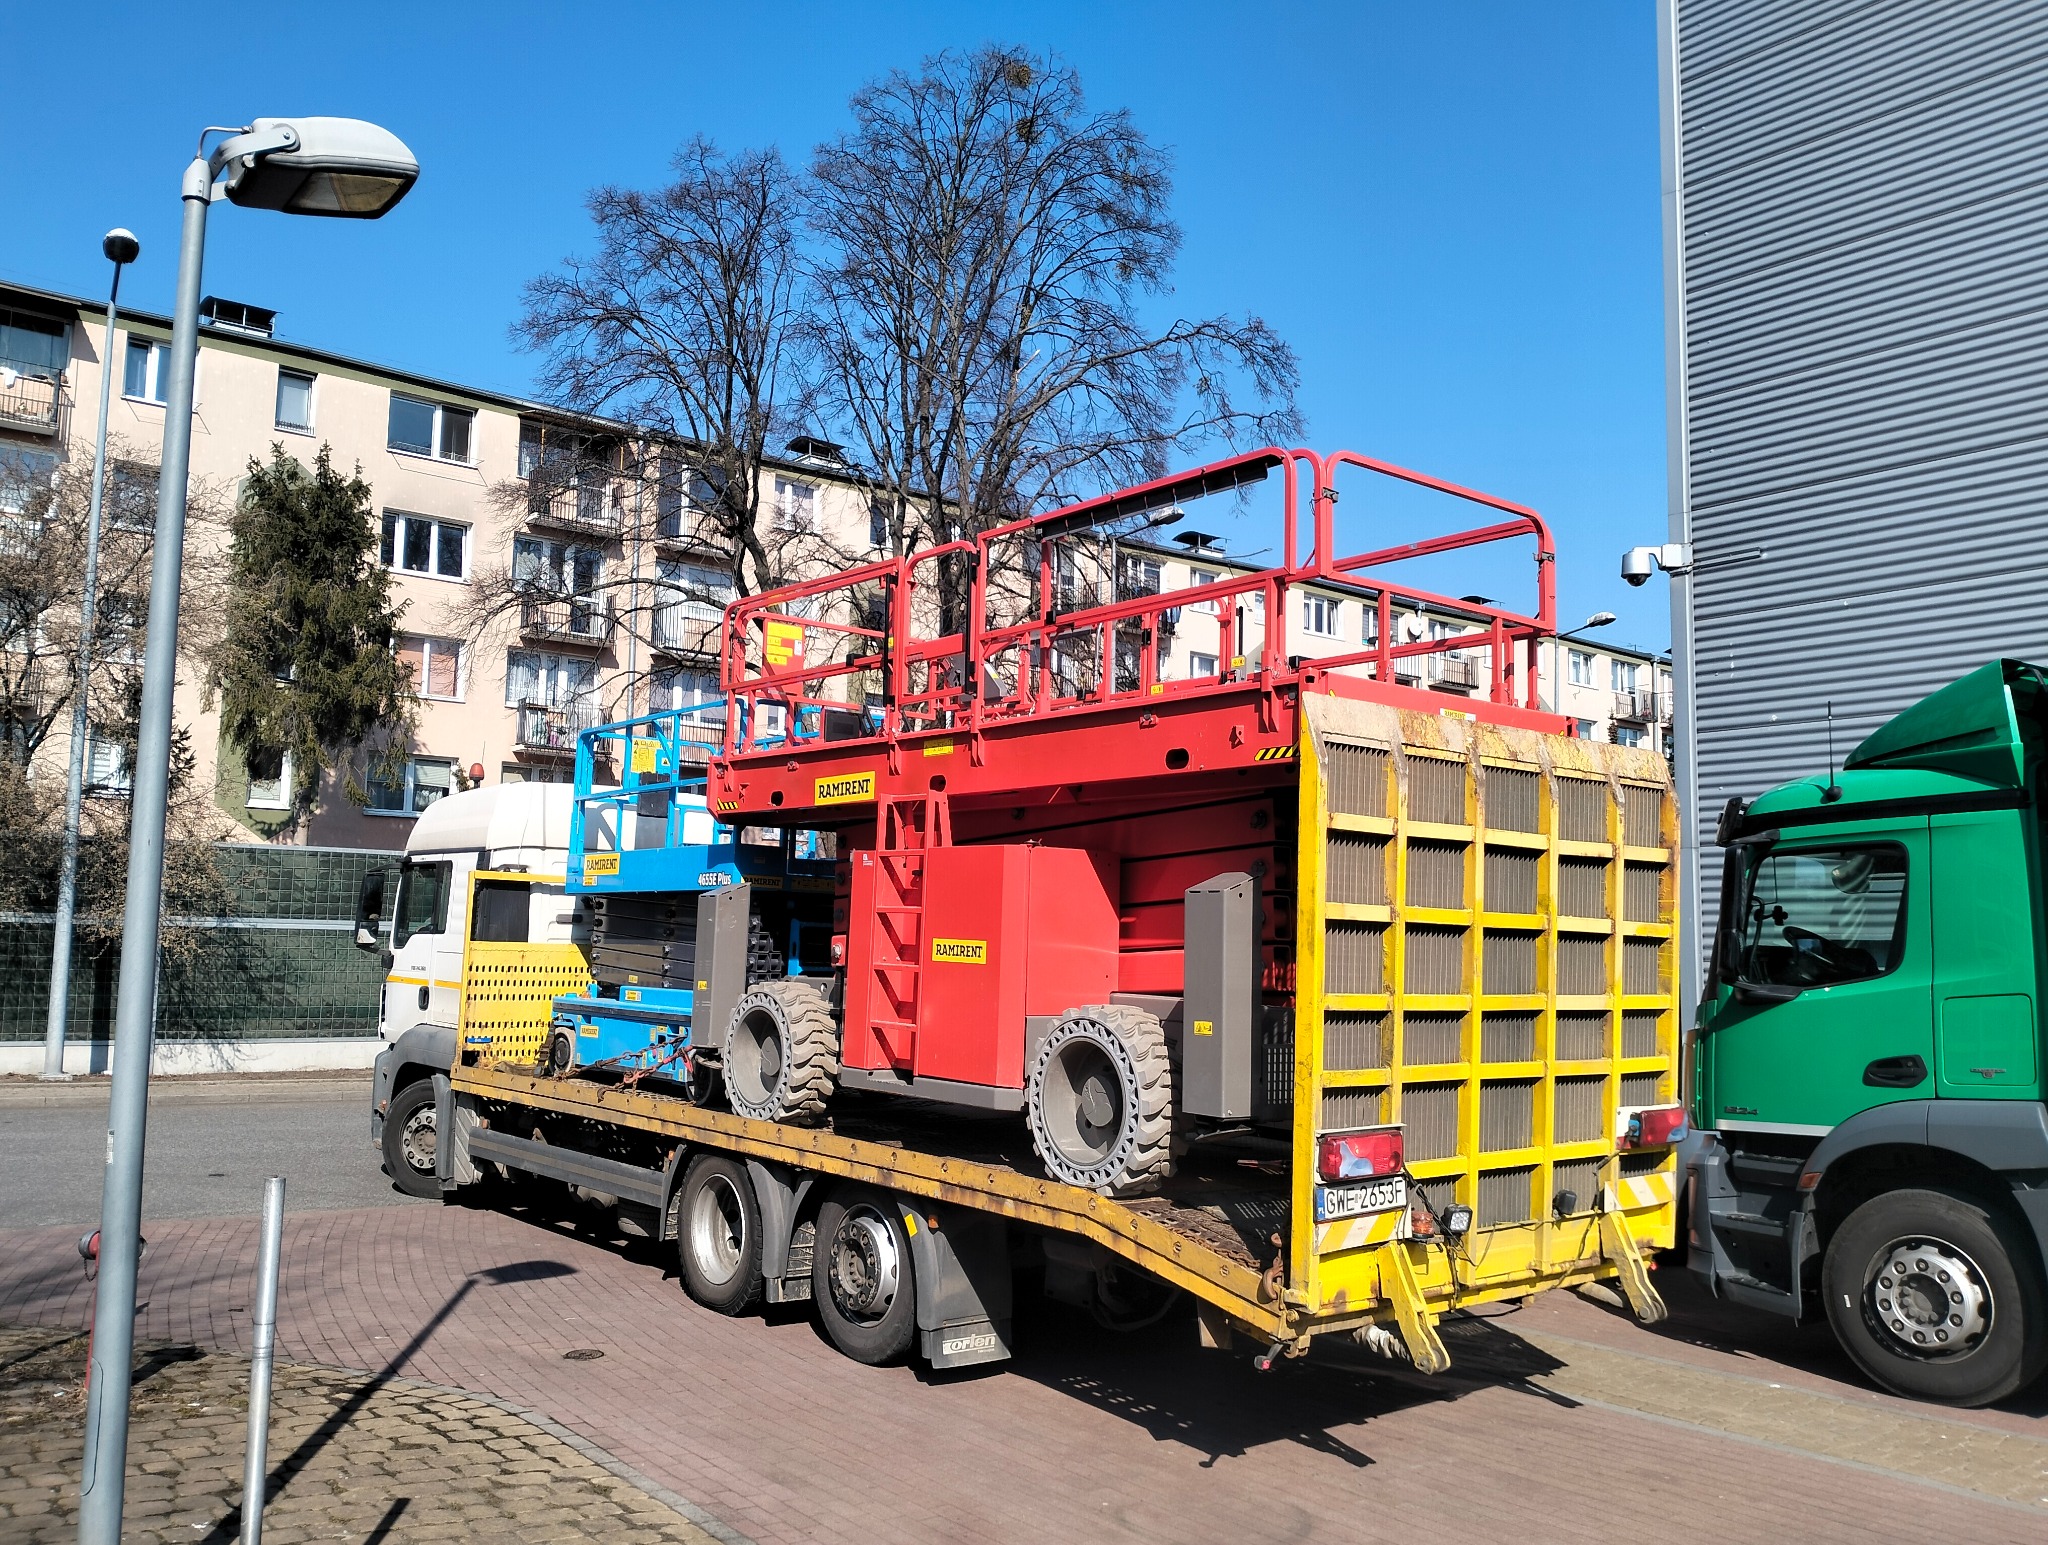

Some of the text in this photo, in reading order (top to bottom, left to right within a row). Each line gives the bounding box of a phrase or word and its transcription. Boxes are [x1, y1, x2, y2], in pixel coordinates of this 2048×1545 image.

[818, 778, 871, 799] RAMIRENT
[586, 857, 618, 872] RAMIRENT
[698, 871, 732, 886] 4655E Plus
[935, 943, 983, 958] RAMIRENT
[1326, 1179, 1403, 1214] GWE 2653F
